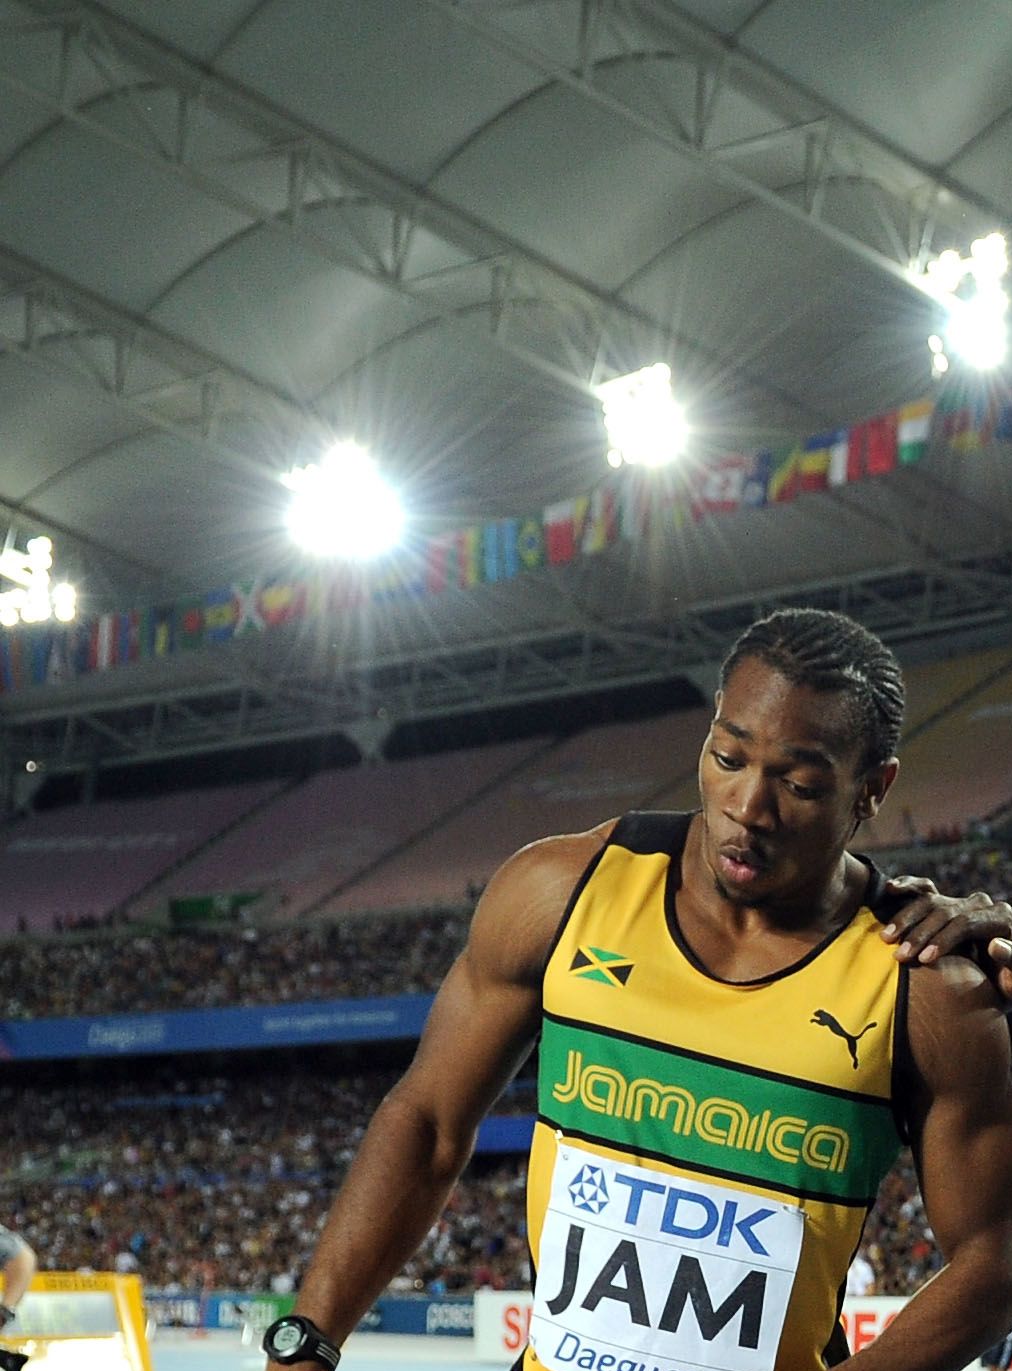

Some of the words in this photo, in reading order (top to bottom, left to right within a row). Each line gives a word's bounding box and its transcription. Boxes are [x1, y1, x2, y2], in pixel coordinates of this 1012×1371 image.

[552, 1049, 850, 1174] Jamaica
[614, 1172, 776, 1257] TDK
[546, 1224, 769, 1350] JAM
